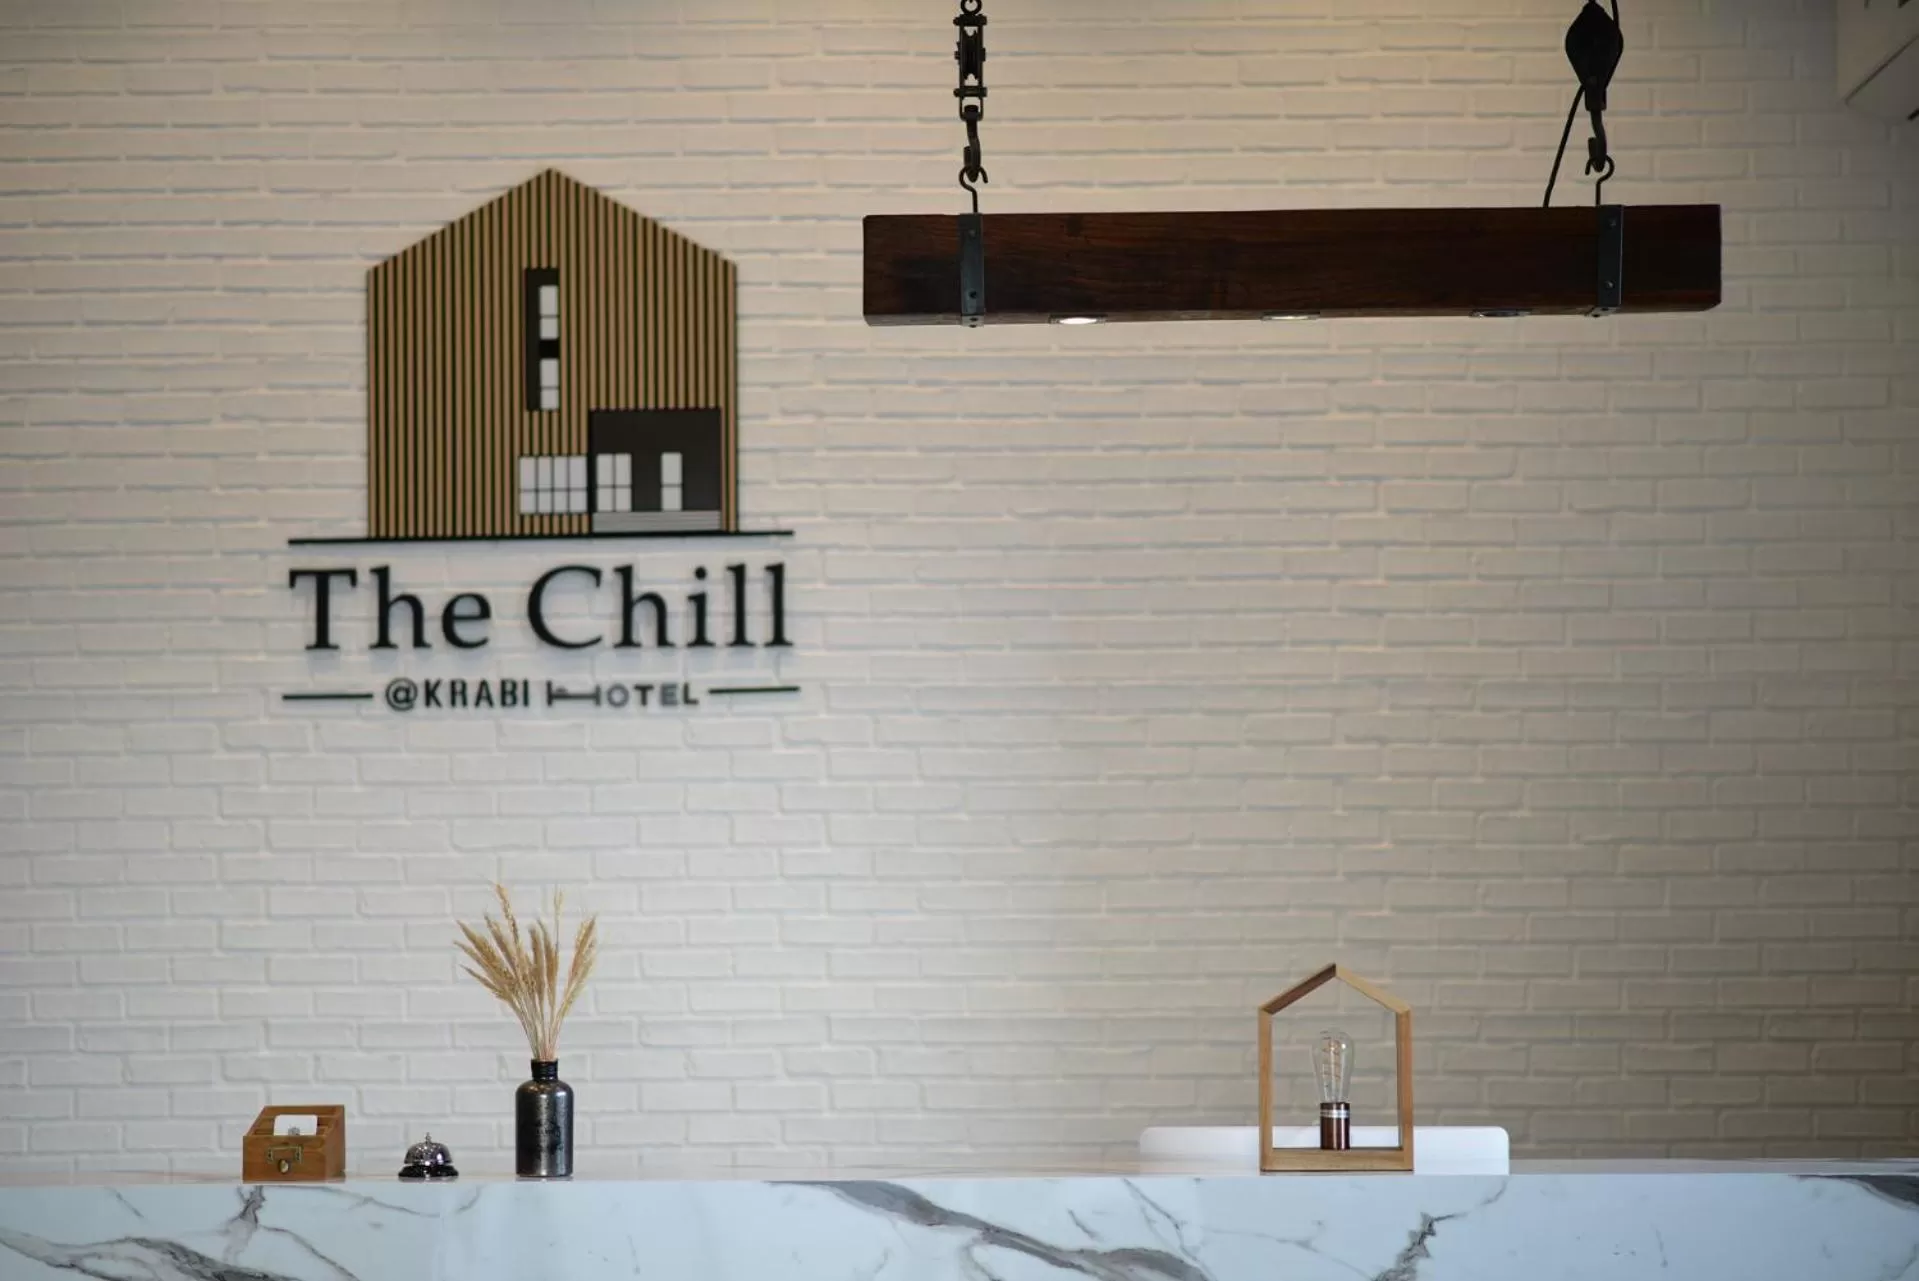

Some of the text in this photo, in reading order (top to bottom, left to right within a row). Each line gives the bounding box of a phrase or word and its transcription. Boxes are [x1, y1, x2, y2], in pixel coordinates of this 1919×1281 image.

[287, 562, 794, 651] The Chill
[384, 676, 700, 712] @KRABI HOTEL
